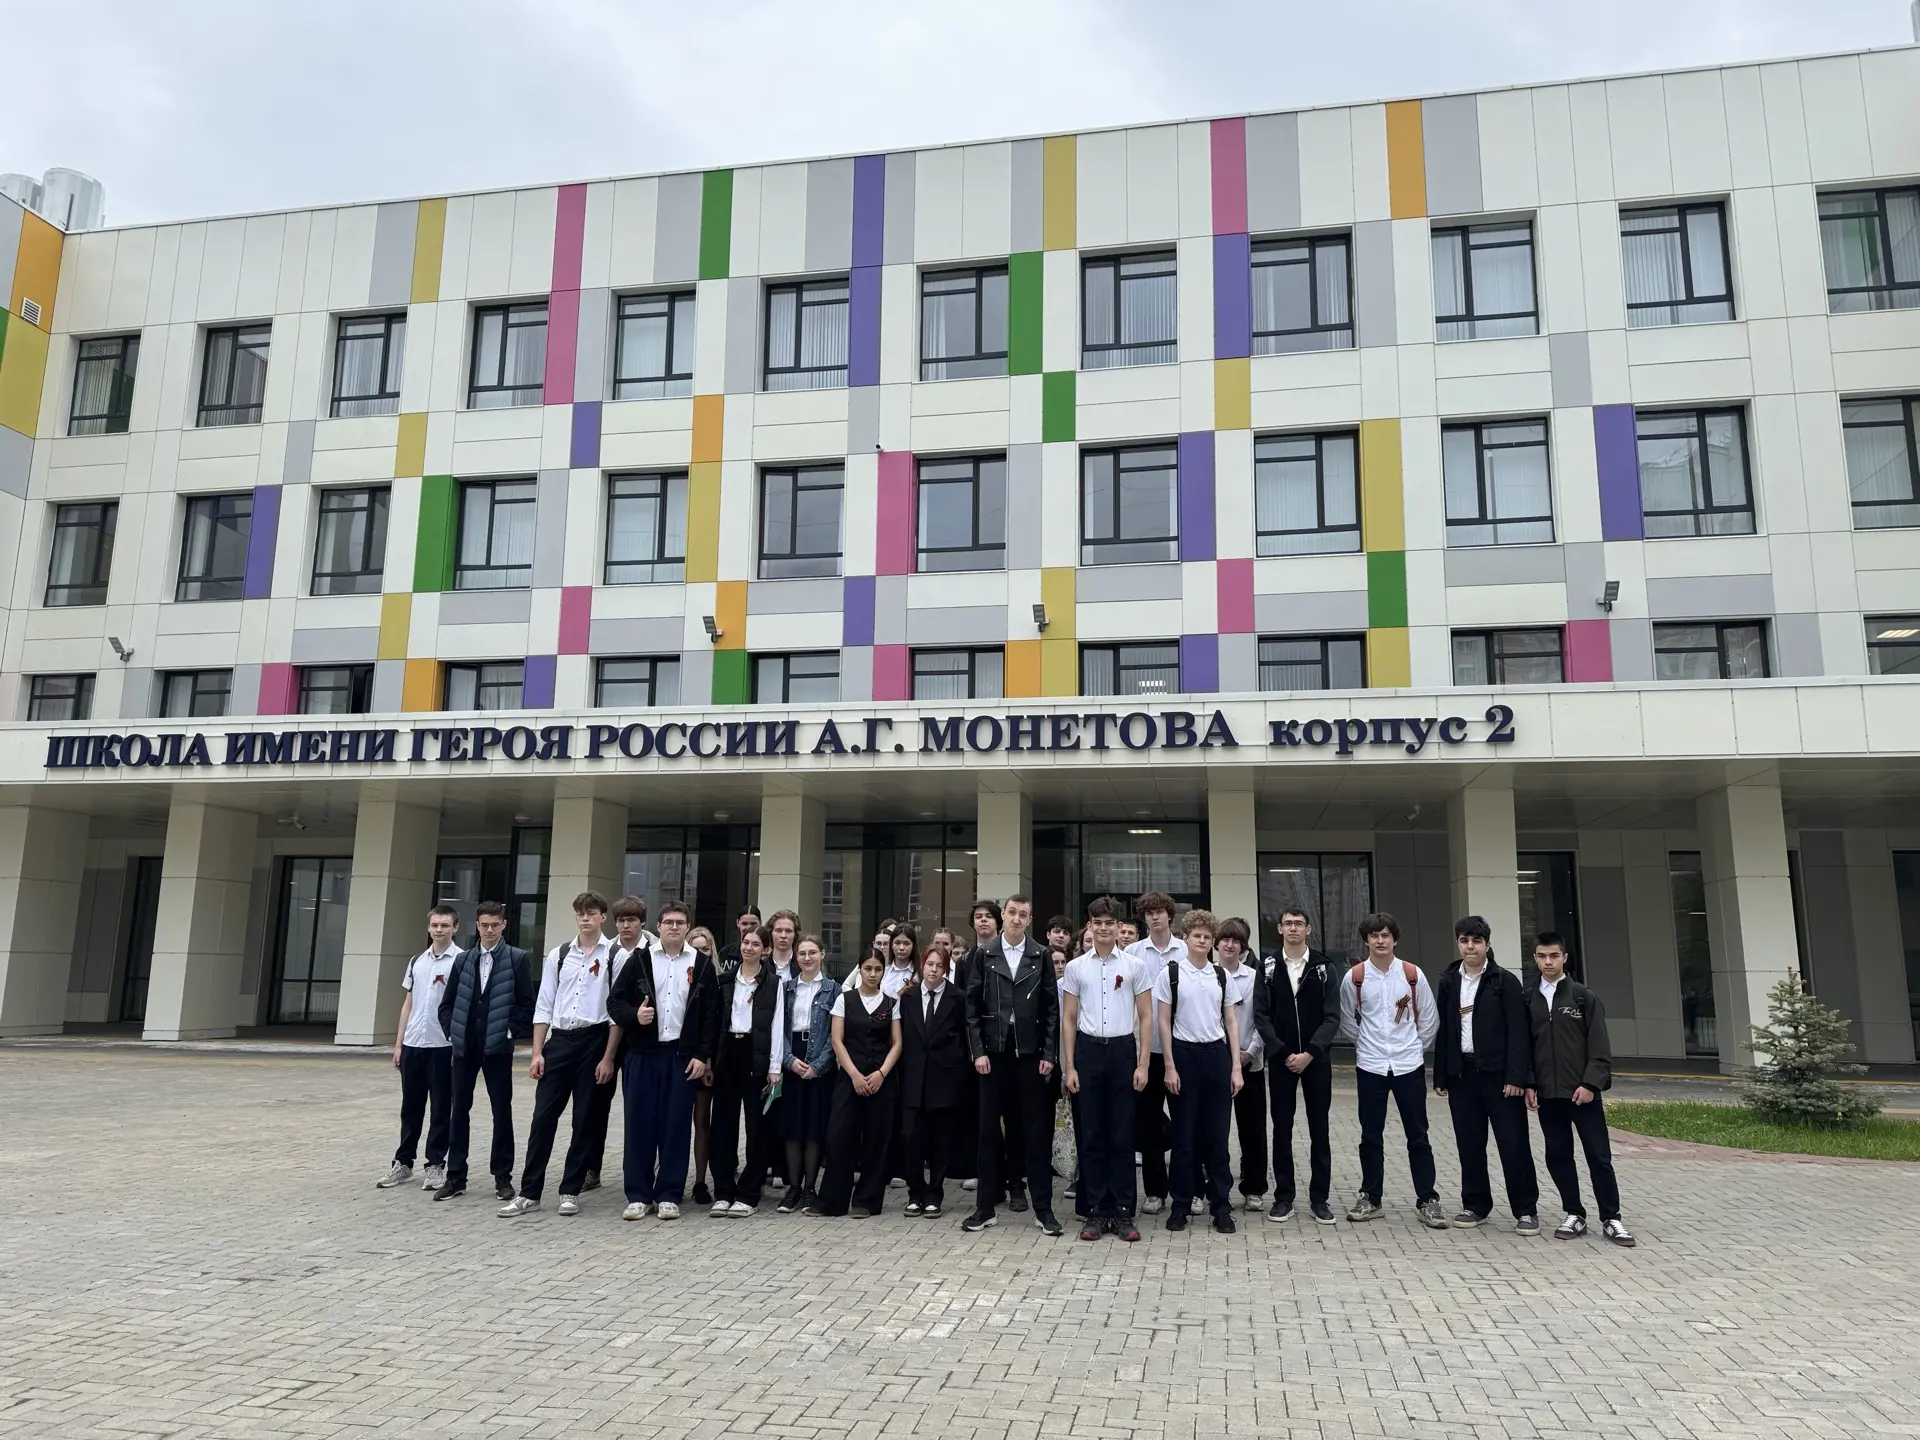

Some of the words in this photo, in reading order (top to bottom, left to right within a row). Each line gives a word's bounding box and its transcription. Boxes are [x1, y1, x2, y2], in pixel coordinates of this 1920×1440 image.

[45, 732, 213, 769] ШКОЛА
[222, 729, 399, 766] ИМЕНИ
[408, 727, 574, 763] ГЕРОЯ
[584, 722, 800, 759] РОССИИ
[811, 718, 905, 755] А.Г.
[918, 711, 1239, 753] МОНЕТОВА
[1269, 717, 1468, 756] корпус
[1485, 704, 1516, 748] 2
